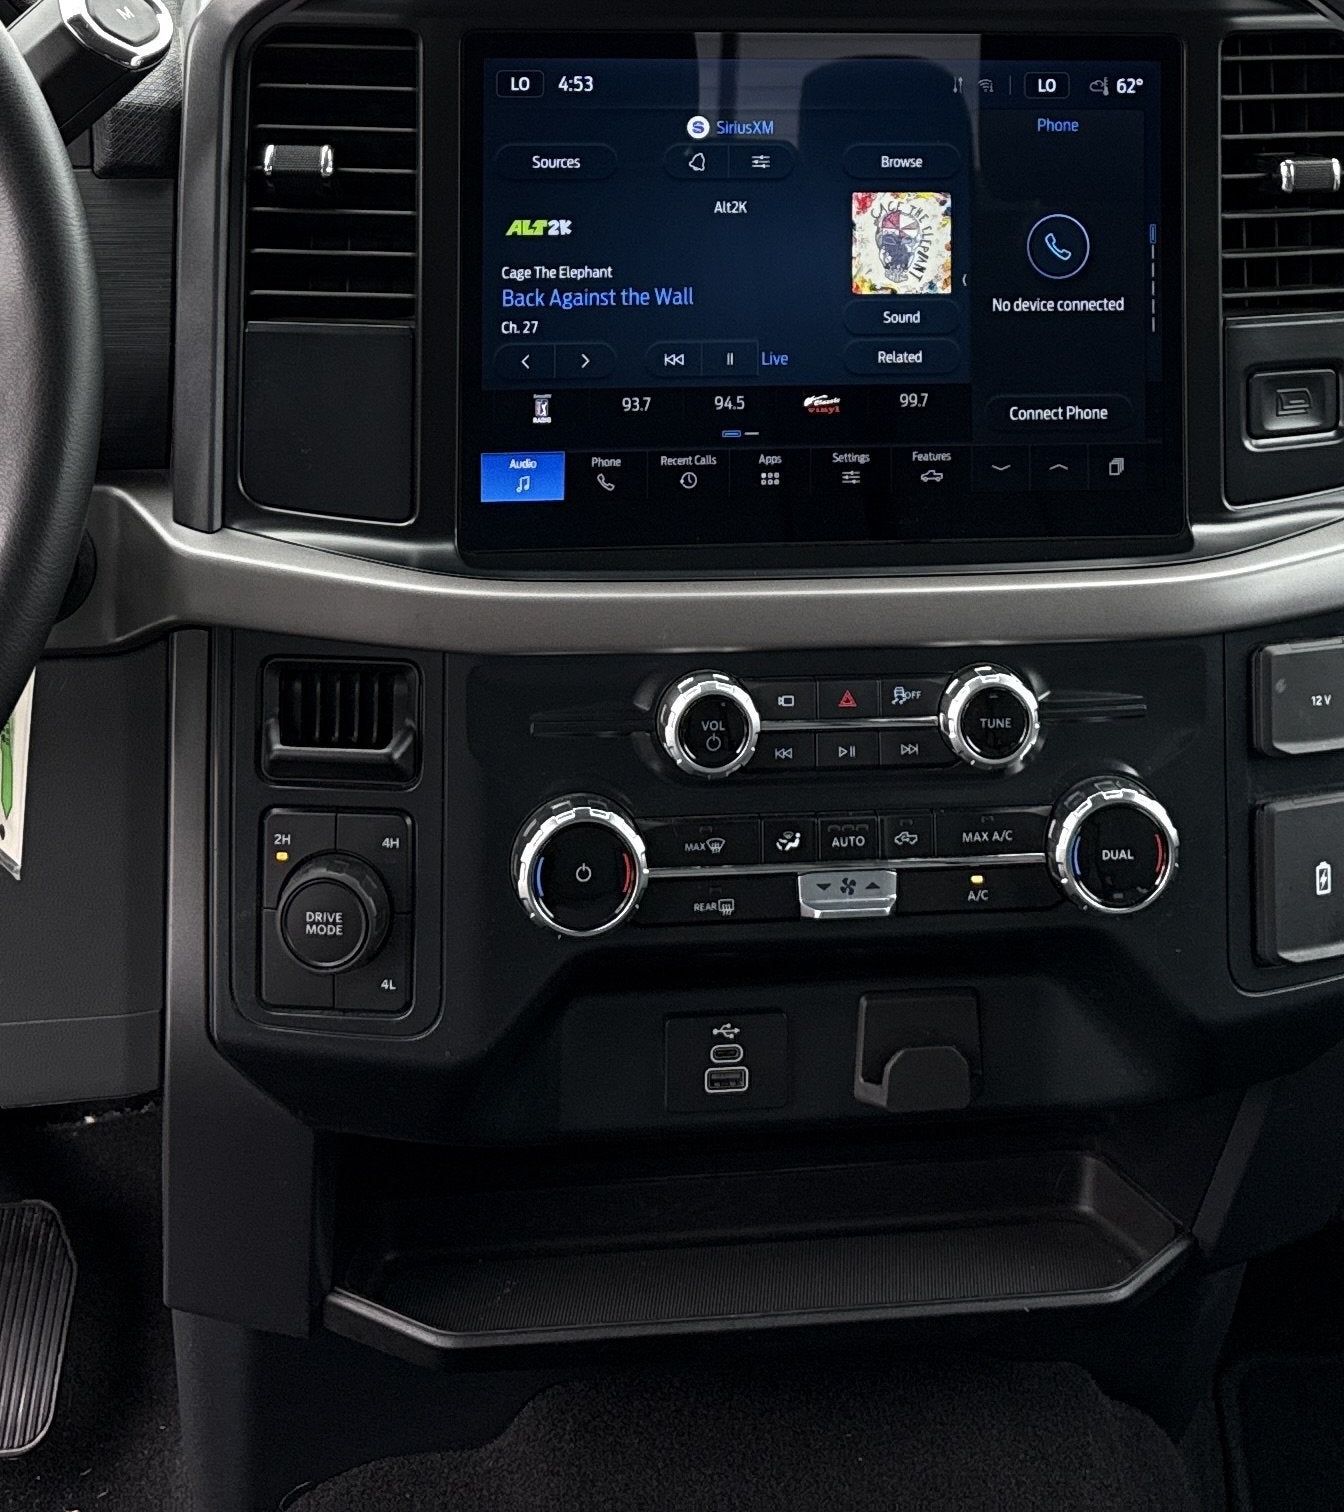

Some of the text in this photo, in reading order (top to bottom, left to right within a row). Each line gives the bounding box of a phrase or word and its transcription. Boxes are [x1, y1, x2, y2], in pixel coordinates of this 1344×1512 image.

[116, 6, 135, 21] M
[510, 76, 594, 92] LO 4:53
[1038, 77, 1144, 93] LO 62°
[716, 120, 775, 135] SiriusXM
[1037, 118, 1080, 133] Phone
[532, 156, 581, 169] Sources
[880, 155, 923, 169] Browse
[714, 201, 748, 214] Alt2K
[506, 219, 573, 236] ALT2K
[501, 265, 613, 281] Cage The Elephant
[502, 287, 694, 309] Back Against the Wall
[992, 297, 1125, 312] No device connected
[883, 310, 921, 324] Sound
[501, 320, 538, 334] Ch. 27
[761, 351, 789, 366] Live
[877, 349, 923, 364] Related
[621, 397, 652, 412] 93.7
[714, 395, 746, 410] 94.5
[899, 393, 929, 408] 99.7
[1009, 406, 1108, 421] Connect Phone
[509, 457, 537, 469] Audio
[591, 456, 622, 468] Phone
[660, 454, 717, 467] Recent Calls
[758, 454, 782, 467] Apps
[832, 452, 870, 464] Settings
[912, 451, 952, 463] Features
[905, 690, 922, 701] OFF
[701, 720, 726, 731] VOL
[979, 717, 1012, 729] TUNE
[273, 833, 291, 846] 2H
[381, 836, 400, 849] 4H
[831, 835, 865, 849] AUTO
[962, 829, 1013, 843] MAX A/C
[684, 842, 706, 852] MAX
[1101, 849, 1134, 861] DUAL
[967, 889, 989, 902] A/C
[693, 902, 717, 912] REAR
[305, 911, 343, 924] DRIVE
[305, 924, 344, 936] MODE
[380, 979, 397, 991] 4L
